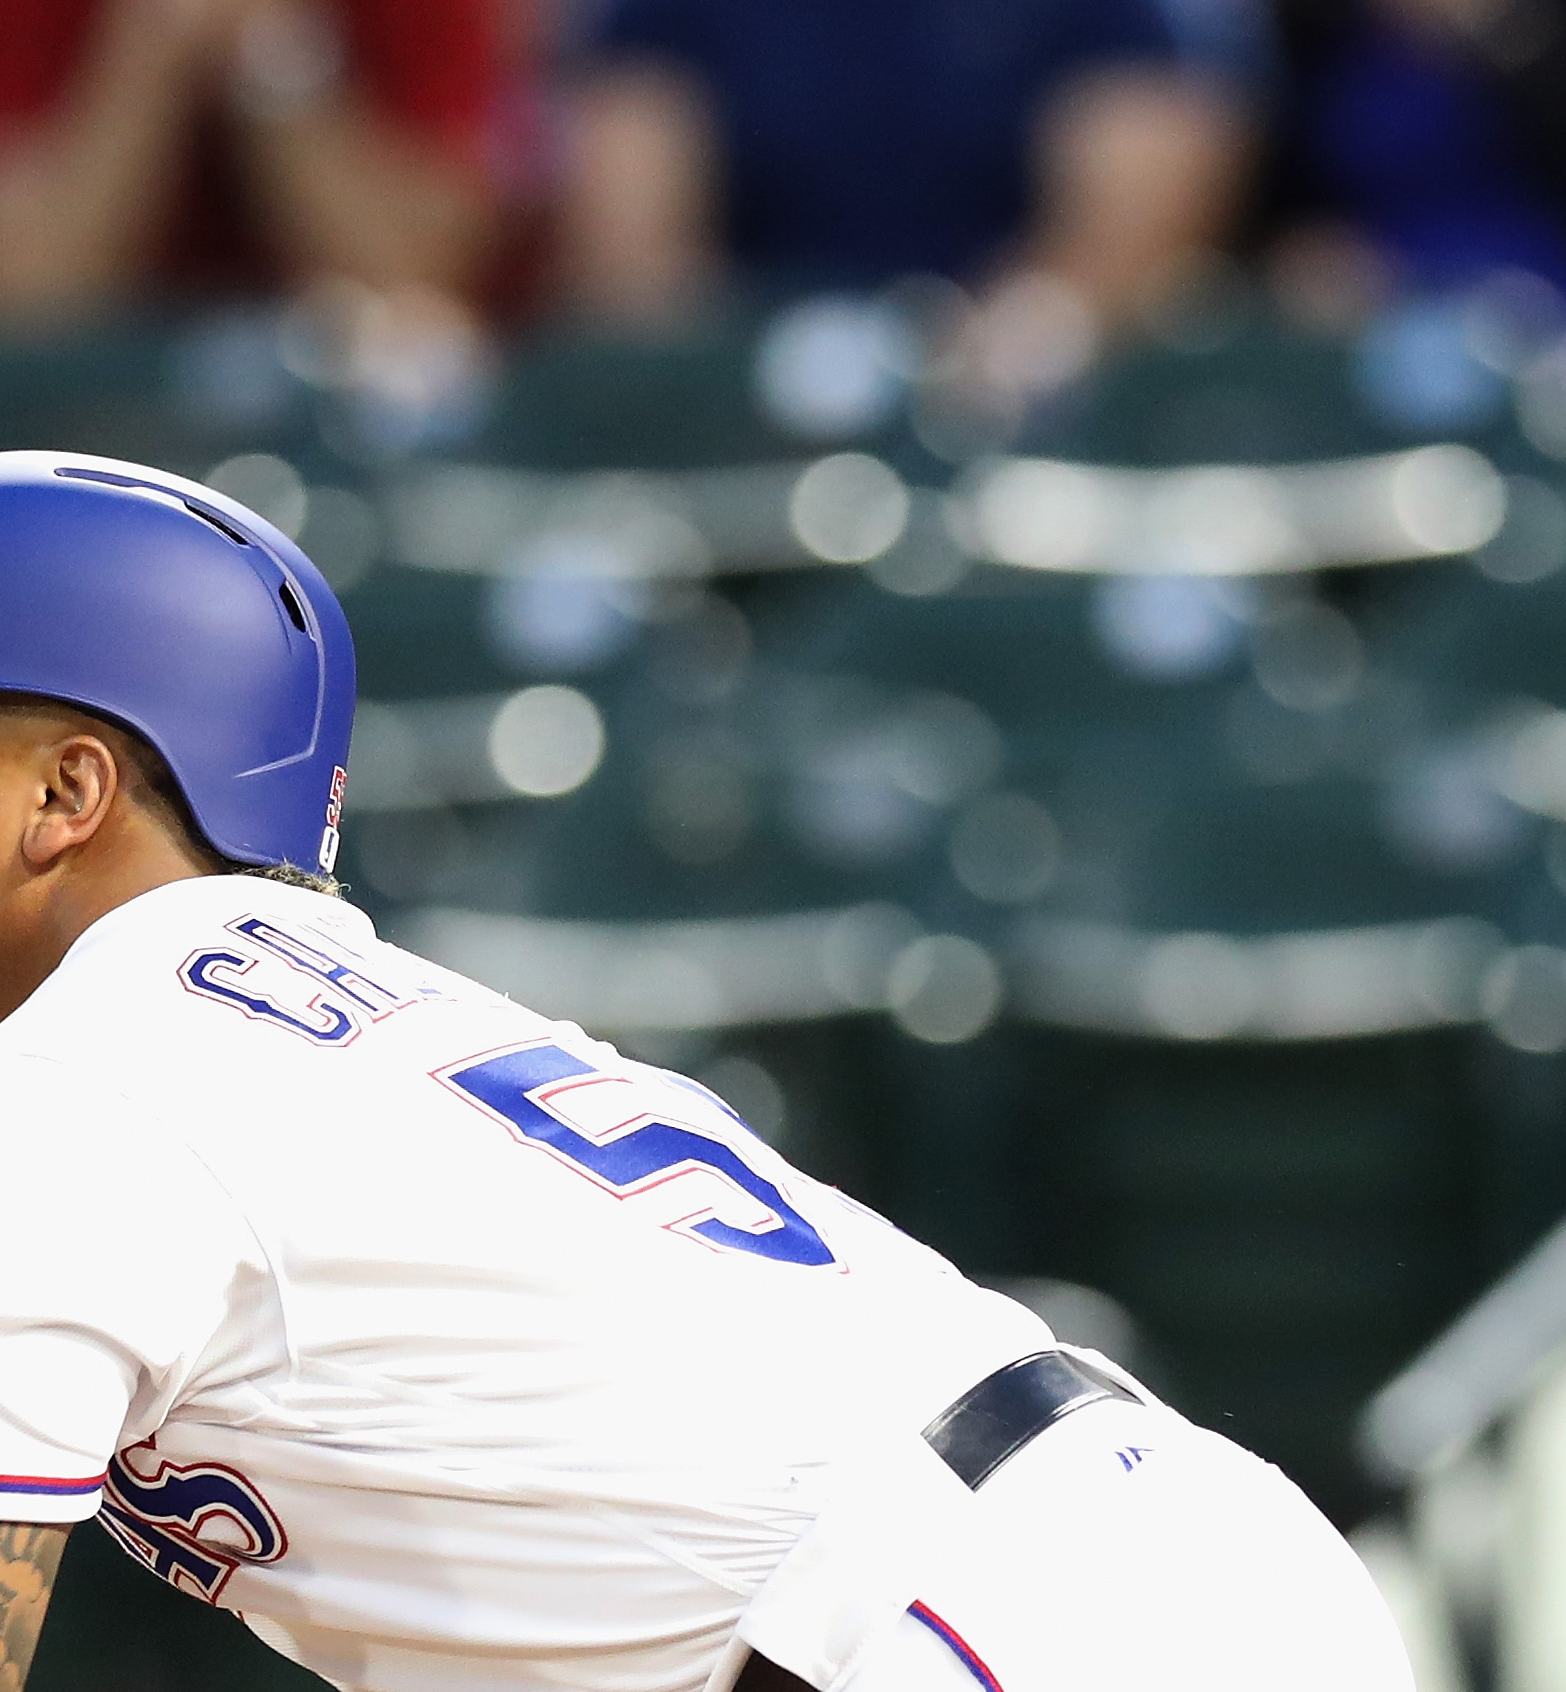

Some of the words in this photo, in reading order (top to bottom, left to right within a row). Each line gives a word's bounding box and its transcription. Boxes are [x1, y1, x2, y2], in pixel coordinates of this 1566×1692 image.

[176, 912, 425, 1048] CA
[427, 1036, 860, 1274] 5
[95, 1433, 289, 1606] AS
